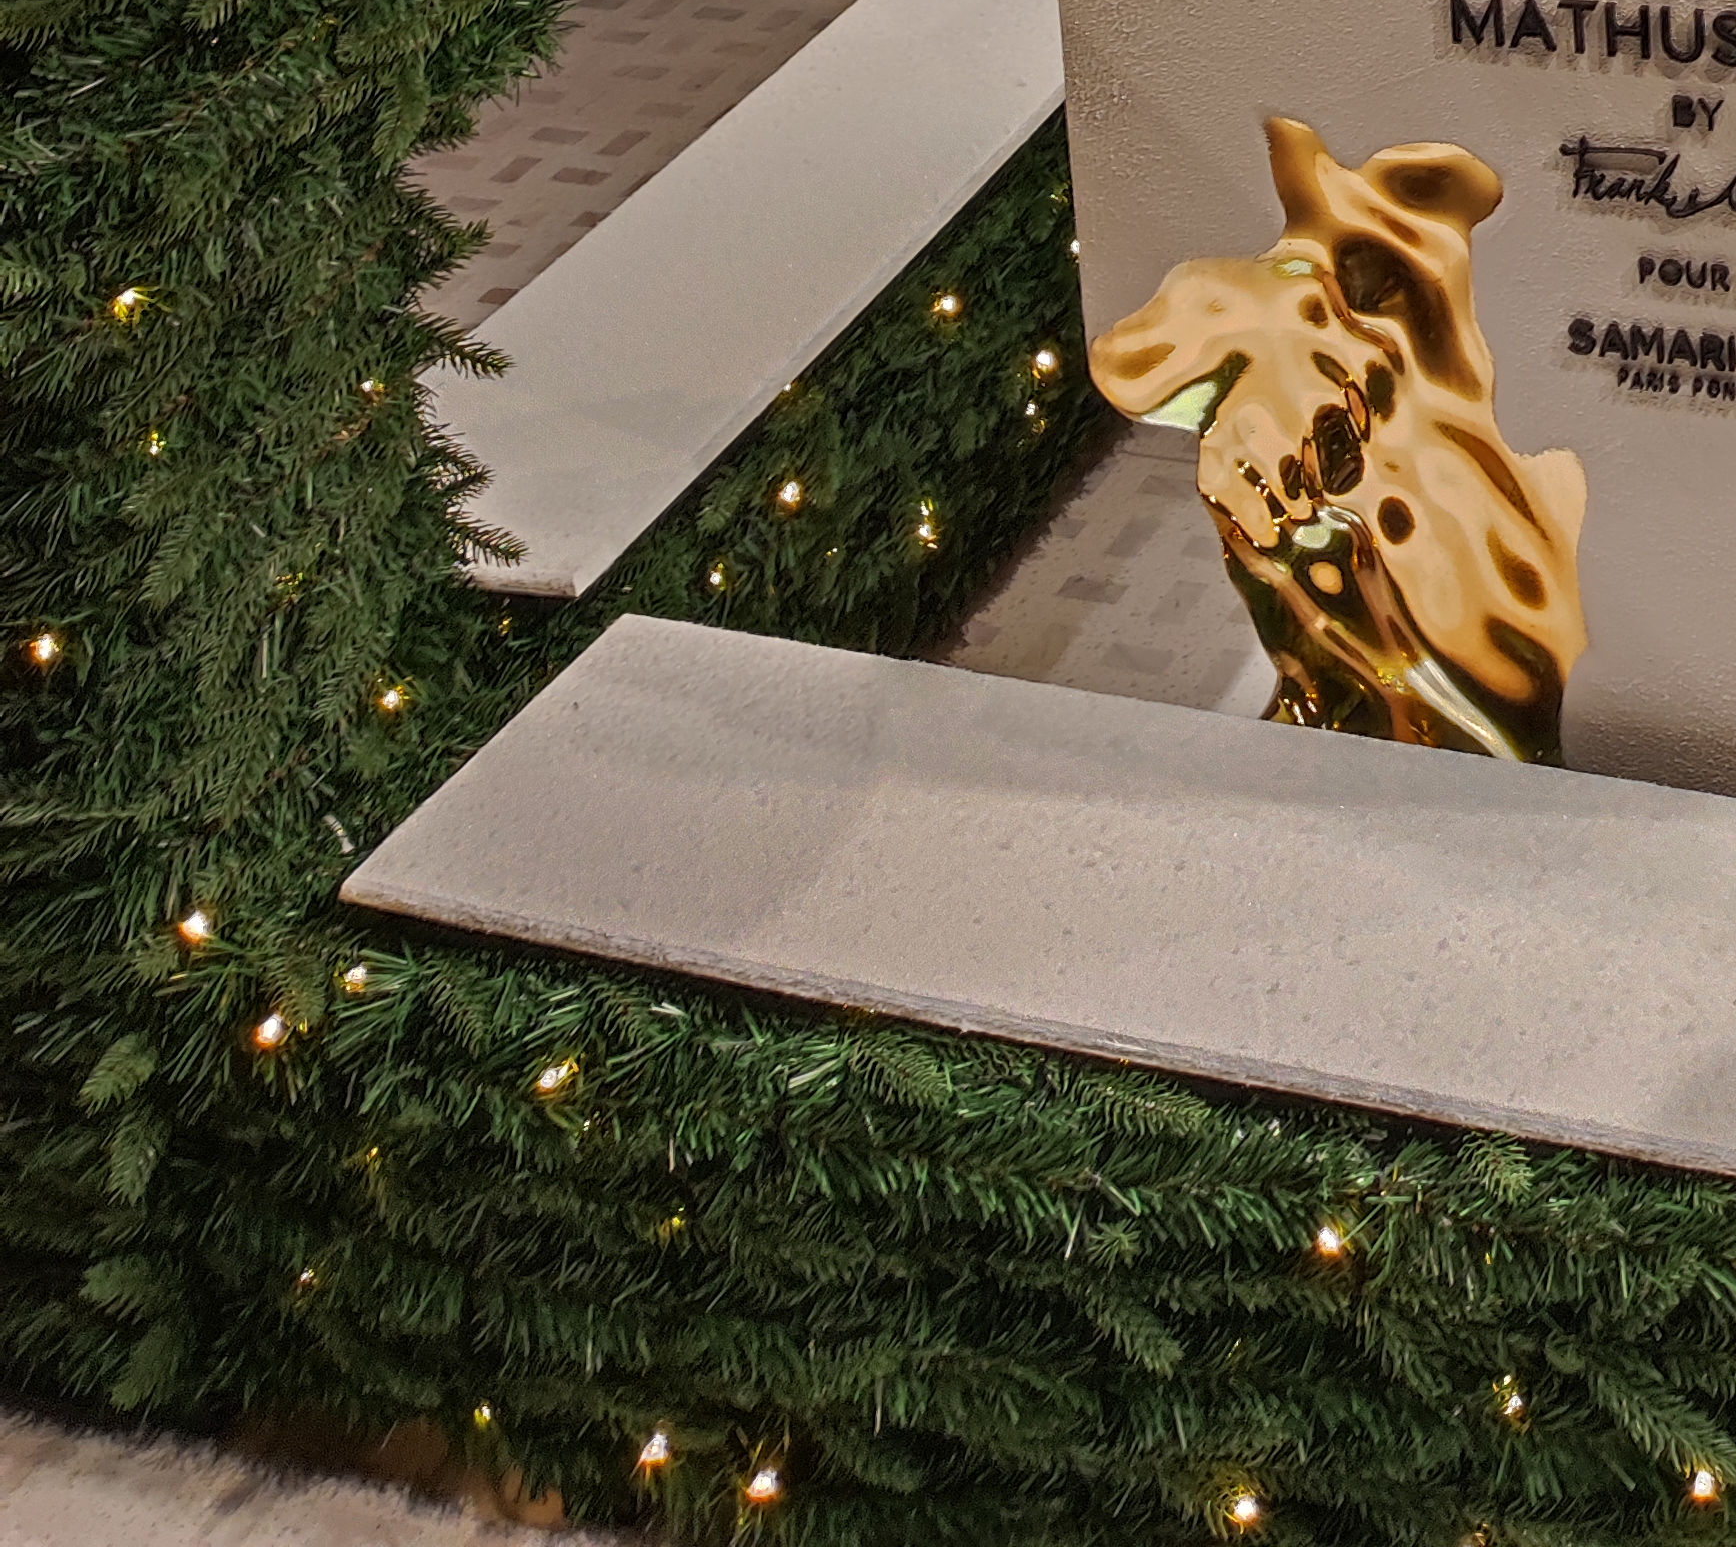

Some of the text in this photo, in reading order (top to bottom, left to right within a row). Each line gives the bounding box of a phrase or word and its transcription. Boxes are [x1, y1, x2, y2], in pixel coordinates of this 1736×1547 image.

[1671, 94, 1725, 132] BY
[1637, 256, 1731, 292] POUR
[1616, 366, 1682, 394] PARIS
